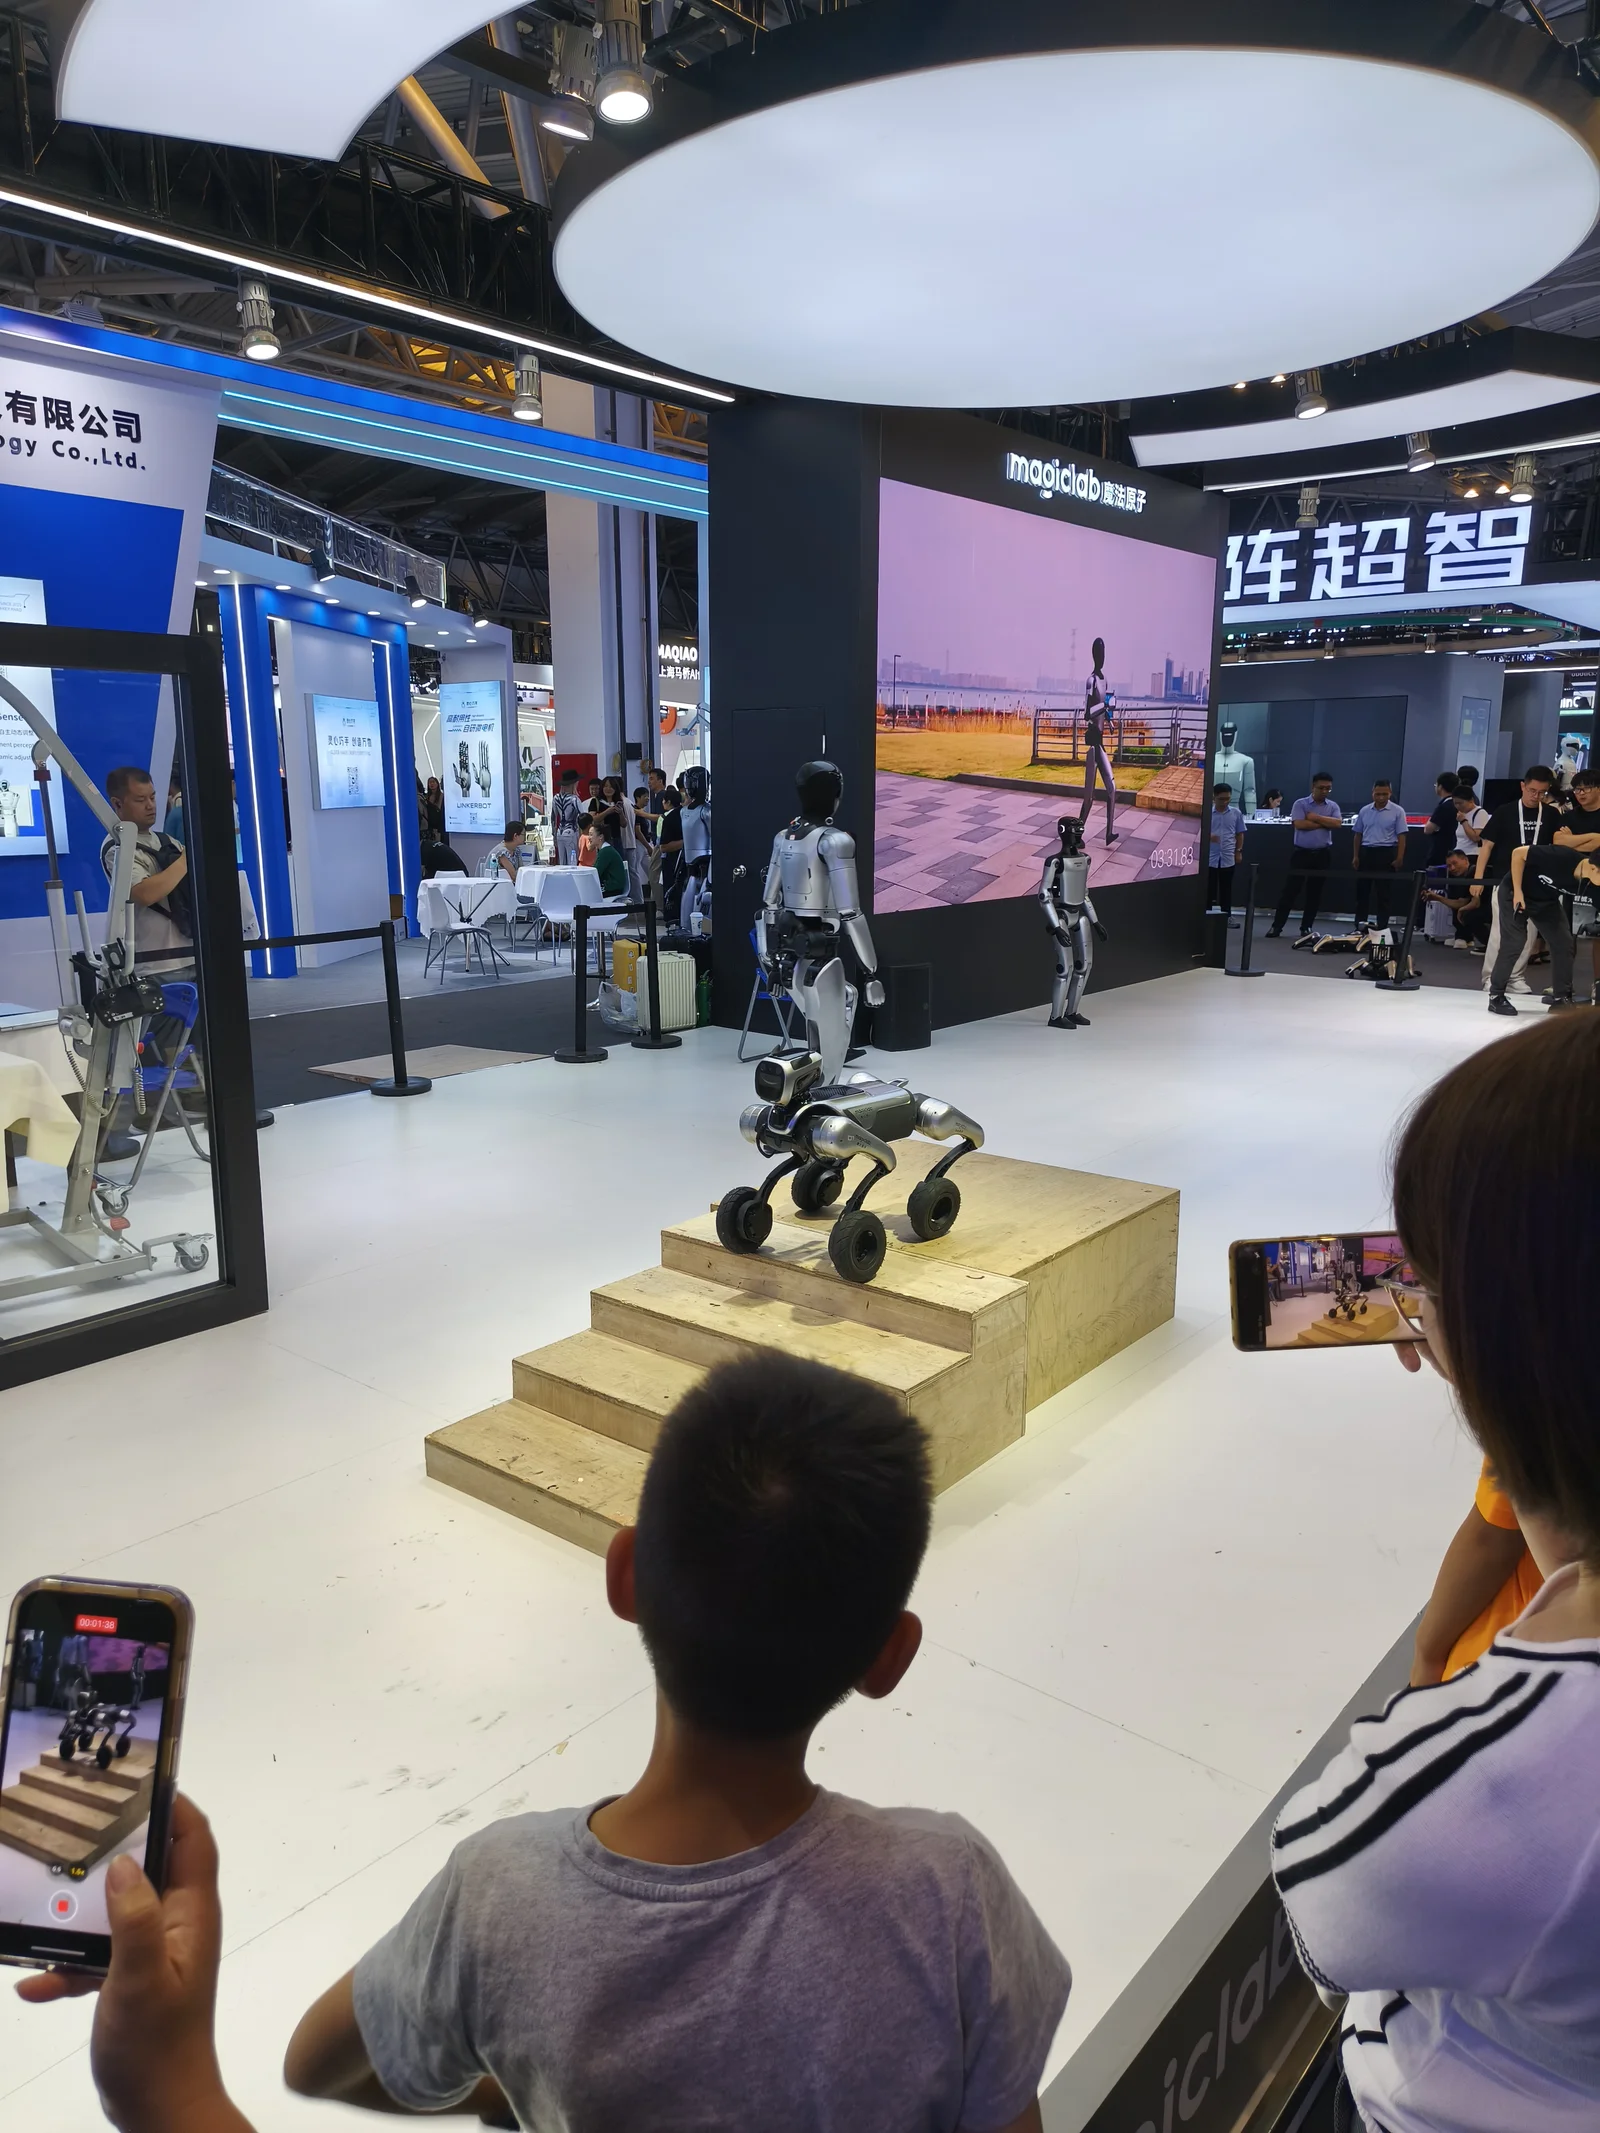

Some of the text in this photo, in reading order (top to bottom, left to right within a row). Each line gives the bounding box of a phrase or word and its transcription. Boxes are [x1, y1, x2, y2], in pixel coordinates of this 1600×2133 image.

[0, 390, 142, 443] 有限公司
[52, 440, 146, 471] Co.,Ltd.
[1007, 452, 1147, 513] magiclab 魔法原子
[1224, 505, 1533, 604] 阵超智
[658, 644, 698, 663] MAQIAO
[1150, 846, 1194, 869] 03:31.83
[80, 1618, 115, 1629] 00:01:38
[1135, 1908, 1295, 2133] iclab
